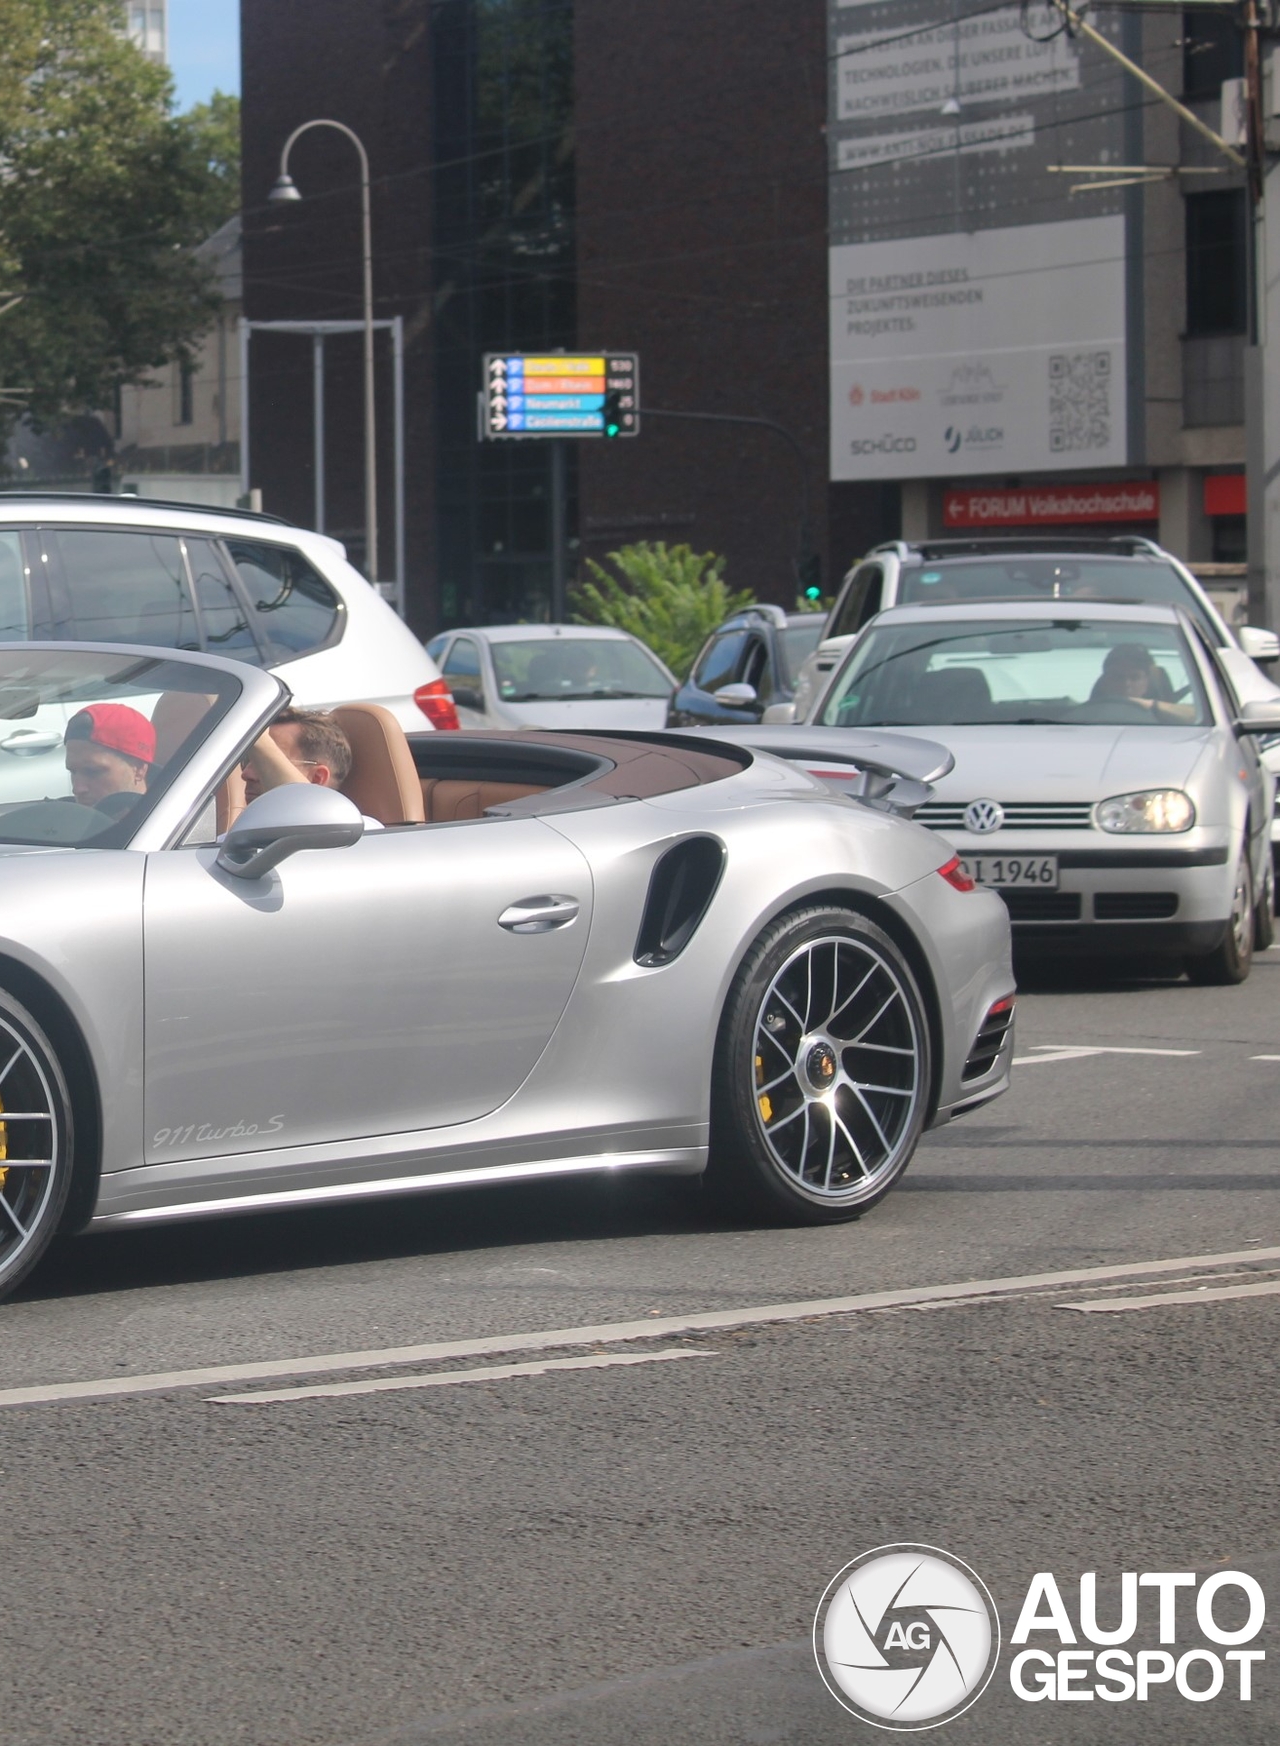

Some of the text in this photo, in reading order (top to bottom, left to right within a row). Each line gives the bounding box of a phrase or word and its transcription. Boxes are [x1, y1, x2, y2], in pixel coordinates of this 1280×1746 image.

[850, 433, 917, 455] SCHÜCO
[970, 490, 1154, 518] FORUM Volkshochschule
[993, 860, 1053, 883] 1946
[153, 1124, 195, 1149] 911
[258, 1114, 286, 1134] S
